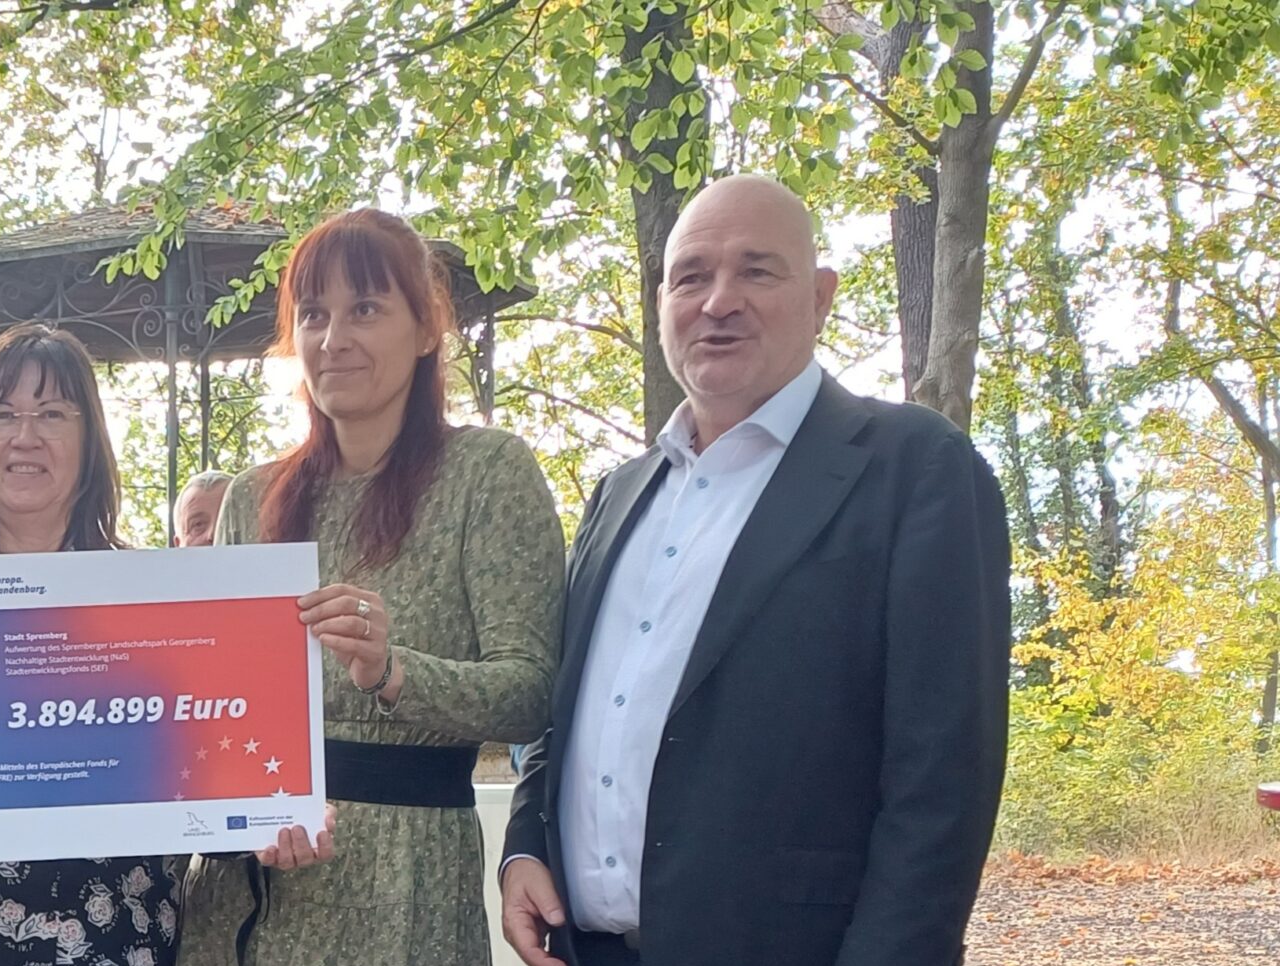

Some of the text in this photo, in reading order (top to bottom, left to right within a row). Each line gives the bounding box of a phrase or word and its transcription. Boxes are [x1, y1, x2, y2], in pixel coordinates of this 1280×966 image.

[4, 632, 67, 642] Stadt Spremberg
[4, 645, 46, 654] Aufwertung
[61, 642, 108, 651] Spremberger
[109, 639, 167, 649] Landschaftspark
[169, 637, 215, 647] Georgenberg
[5, 656, 47, 666] Nachhaltige
[48, 653, 109, 664] Stadtentwicklung
[5, 664, 108, 676] Stadtentwicklungsfonds (SEF)
[8, 694, 247, 729] 3.894.899 Euro
[0, 763, 25, 771] Mitteln
[26, 762, 38, 770] des
[40, 760, 86, 770] Europäischen
[87, 759, 107, 768] Fonds
[108, 758, 120, 768] für
[14, 774, 26, 782] zur
[27, 771, 61, 782] Verfügung
